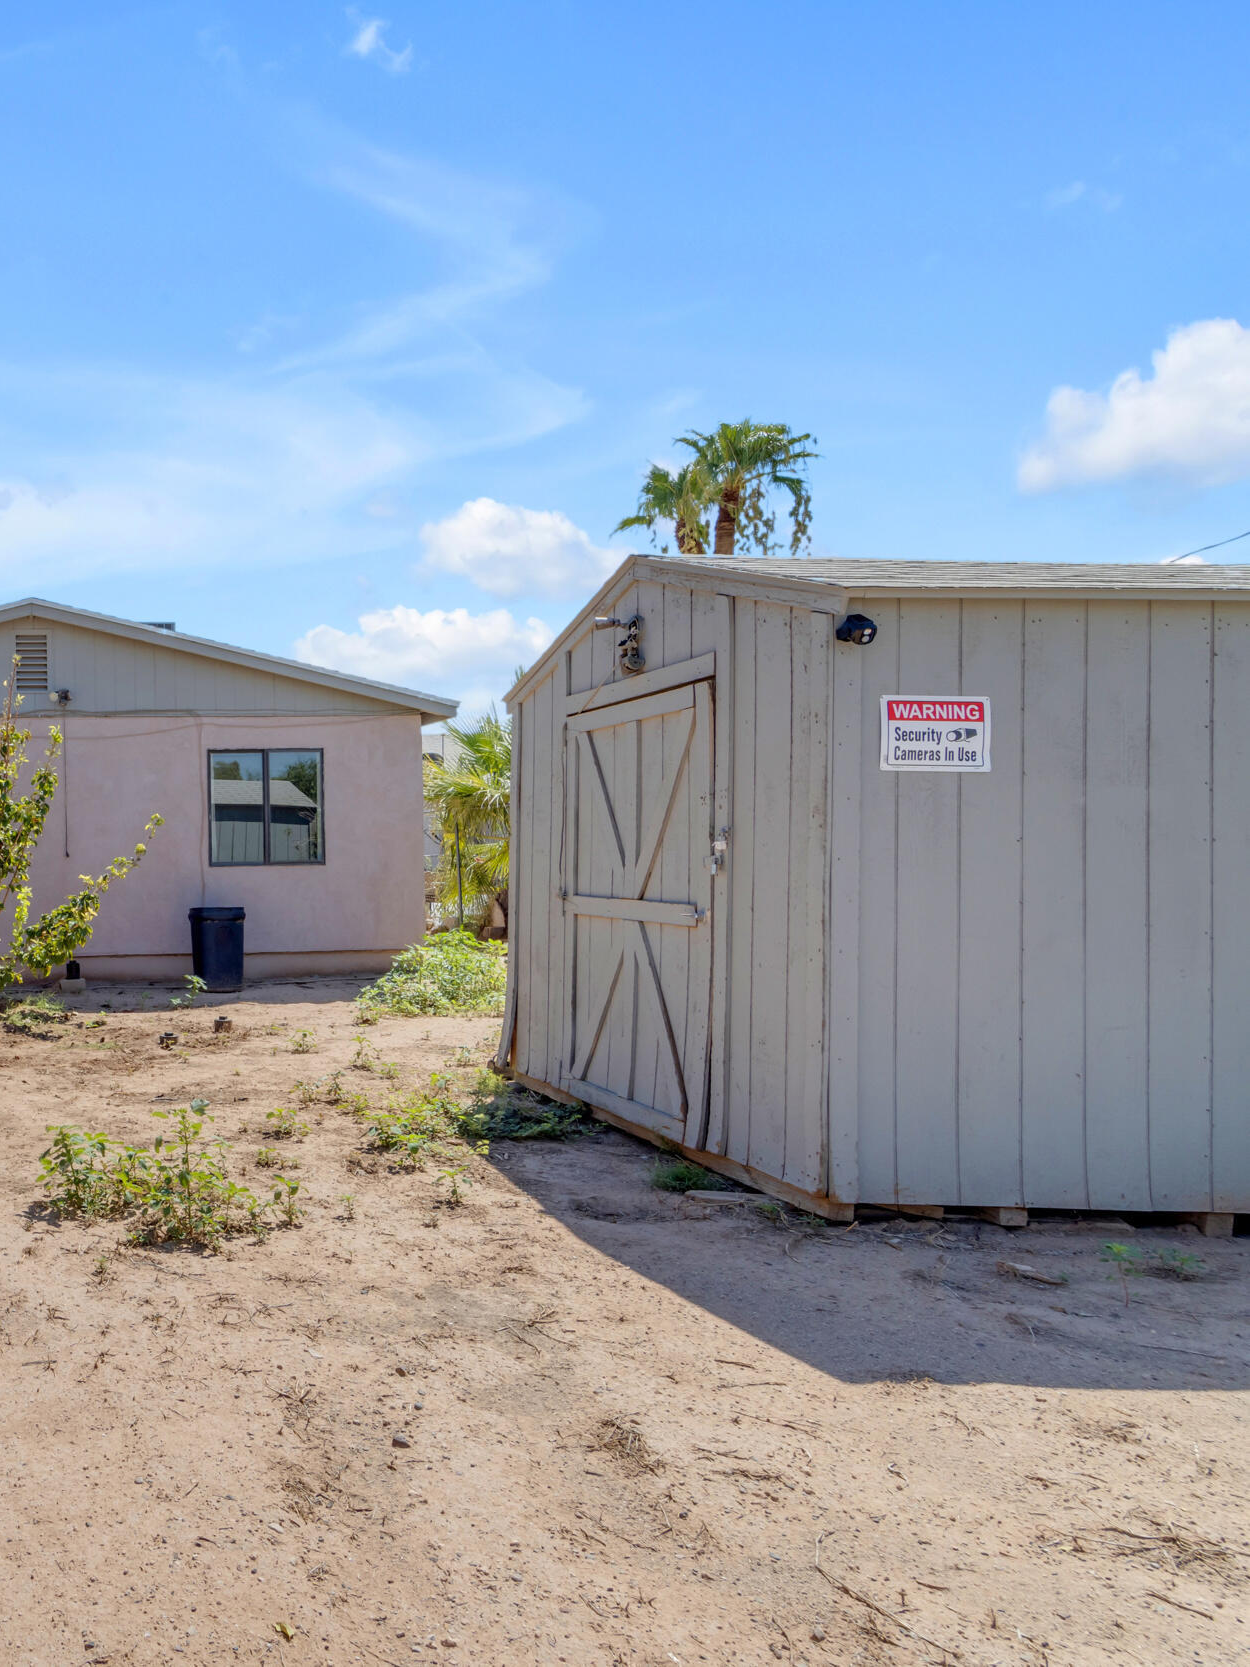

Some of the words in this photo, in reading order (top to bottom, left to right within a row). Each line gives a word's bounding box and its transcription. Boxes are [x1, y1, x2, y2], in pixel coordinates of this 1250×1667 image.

[892, 703, 980, 720] WARNING
[894, 726, 942, 745] Security
[894, 745, 941, 761] Cameras
[944, 746, 955, 762] In
[958, 747, 977, 762] Use
